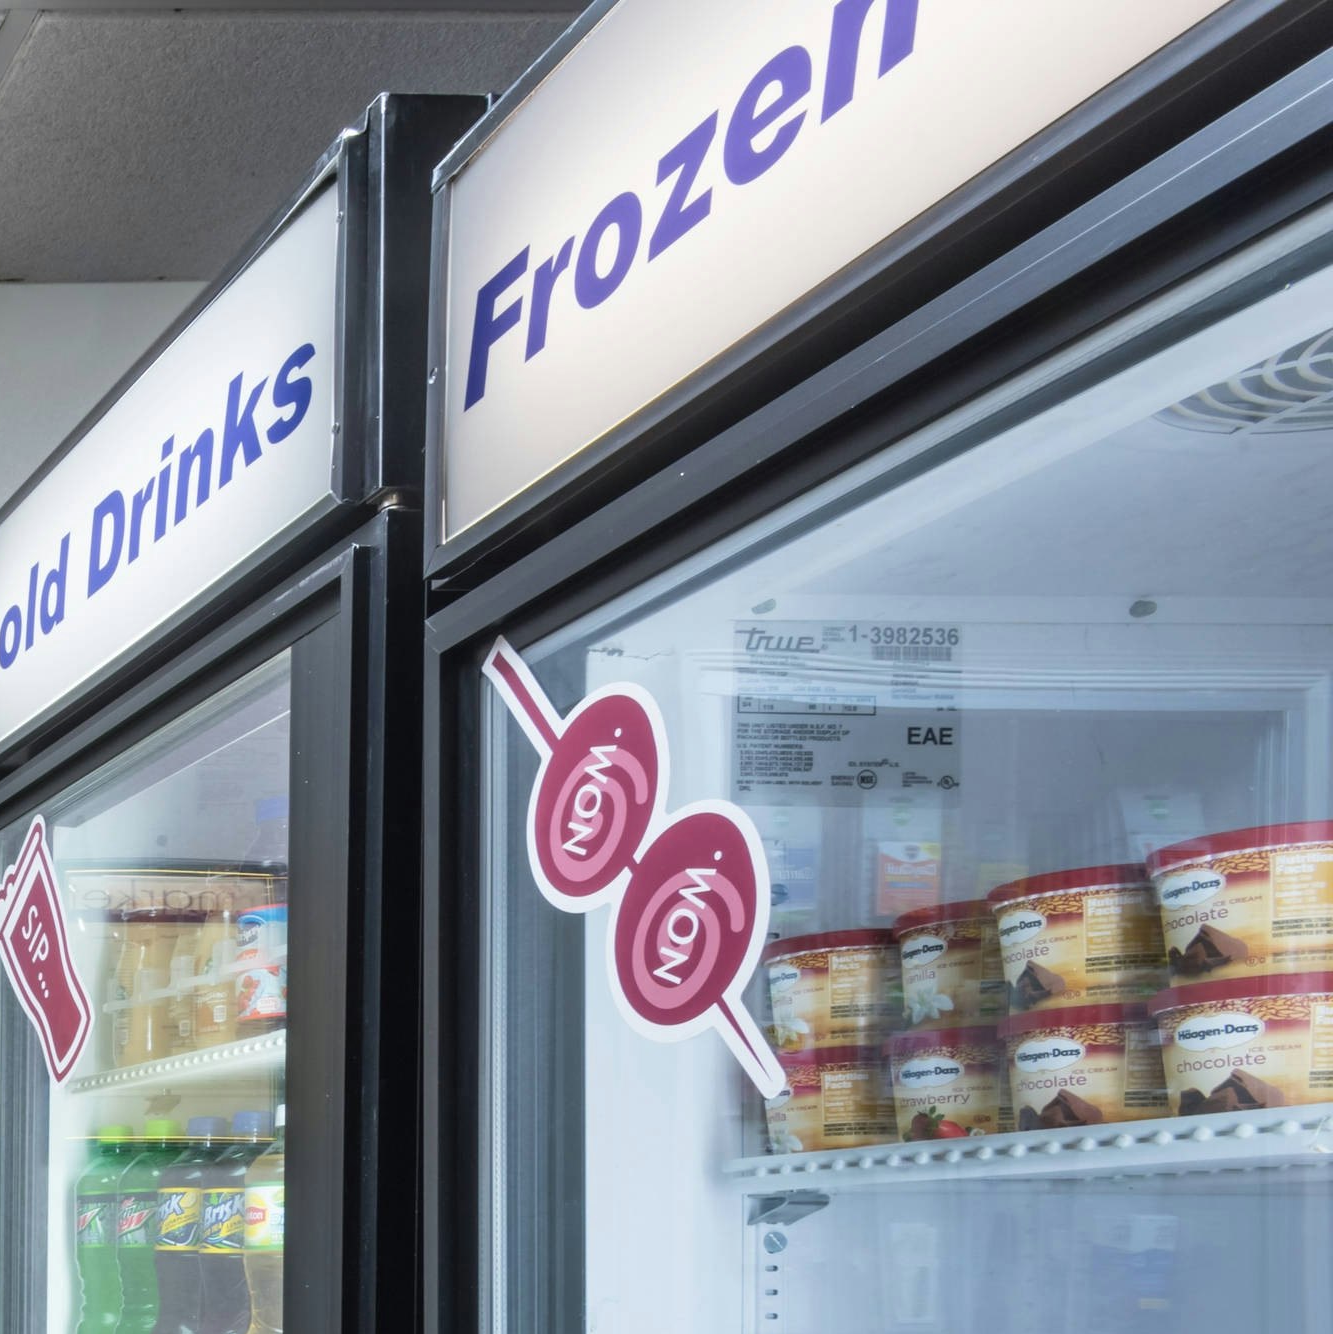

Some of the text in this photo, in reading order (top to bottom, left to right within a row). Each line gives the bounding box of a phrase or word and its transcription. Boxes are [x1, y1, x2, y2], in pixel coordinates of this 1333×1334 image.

[463, 0, 920, 413] Frozen
[86, 342, 316, 600] Drinks
[849, 625, 960, 646] 1-3982536
[906, 726, 954, 746] EAE
[1228, 895, 1263, 905] CREAM
[1267, 1043, 1302, 1052] CREAM
[1087, 1066, 1118, 1074] CREAM
[1176, 1053, 1267, 1074] chocolate
